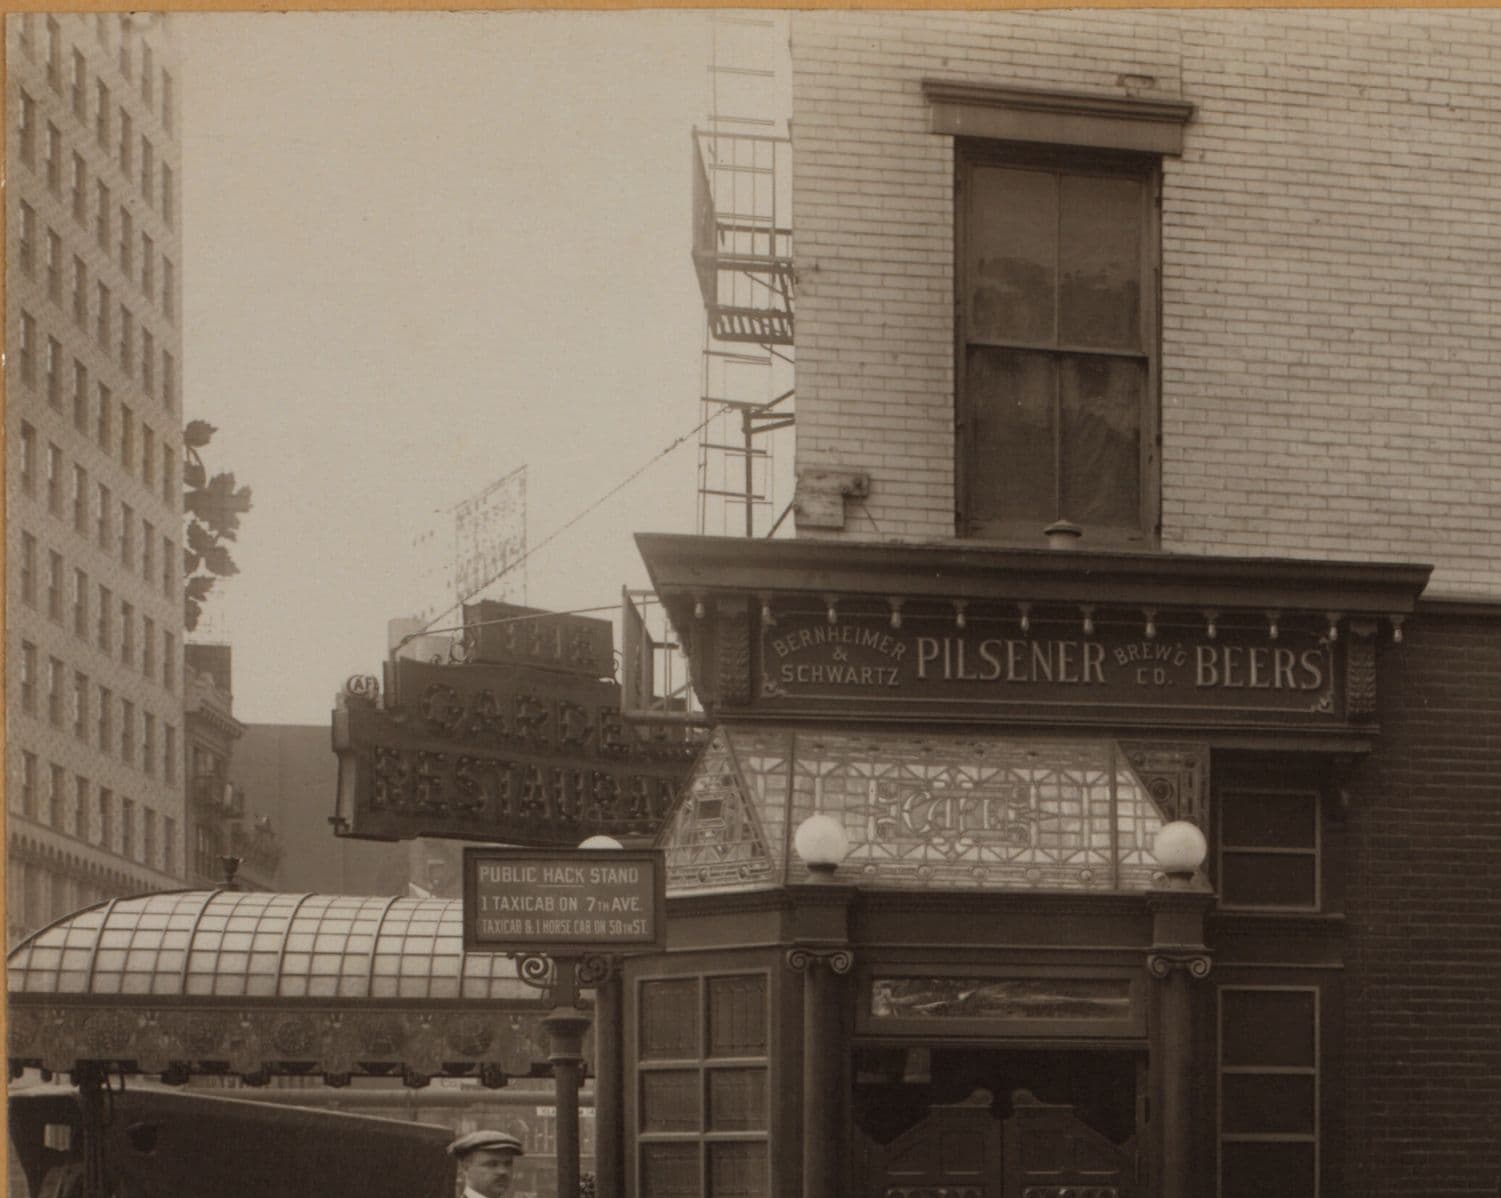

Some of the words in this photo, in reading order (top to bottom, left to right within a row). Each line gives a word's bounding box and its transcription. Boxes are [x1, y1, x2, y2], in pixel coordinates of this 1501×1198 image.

[773, 625, 906, 661] BERNHEIMER
[833, 647, 848, 662] &
[917, 636, 1106, 683] PILSENER
[1195, 645, 1323, 689] BEERS
[780, 663, 900, 688] SCHWARTZ
[1136, 666, 1174, 685] CO.
[424, 683, 645, 757] GARDE
[479, 866, 537, 883] PUBLIC
[543, 866, 585, 884] HACK
[590, 867, 639, 884] STAND
[480, 895, 488, 912] 1
[492, 896, 554, 912] TAXICAB
[559, 896, 578, 912] ON
[482, 919, 522, 935] TAXICAB
[542, 919, 571, 935] HORSE
[574, 919, 591, 935] CAB
[594, 919, 606, 935] ON
